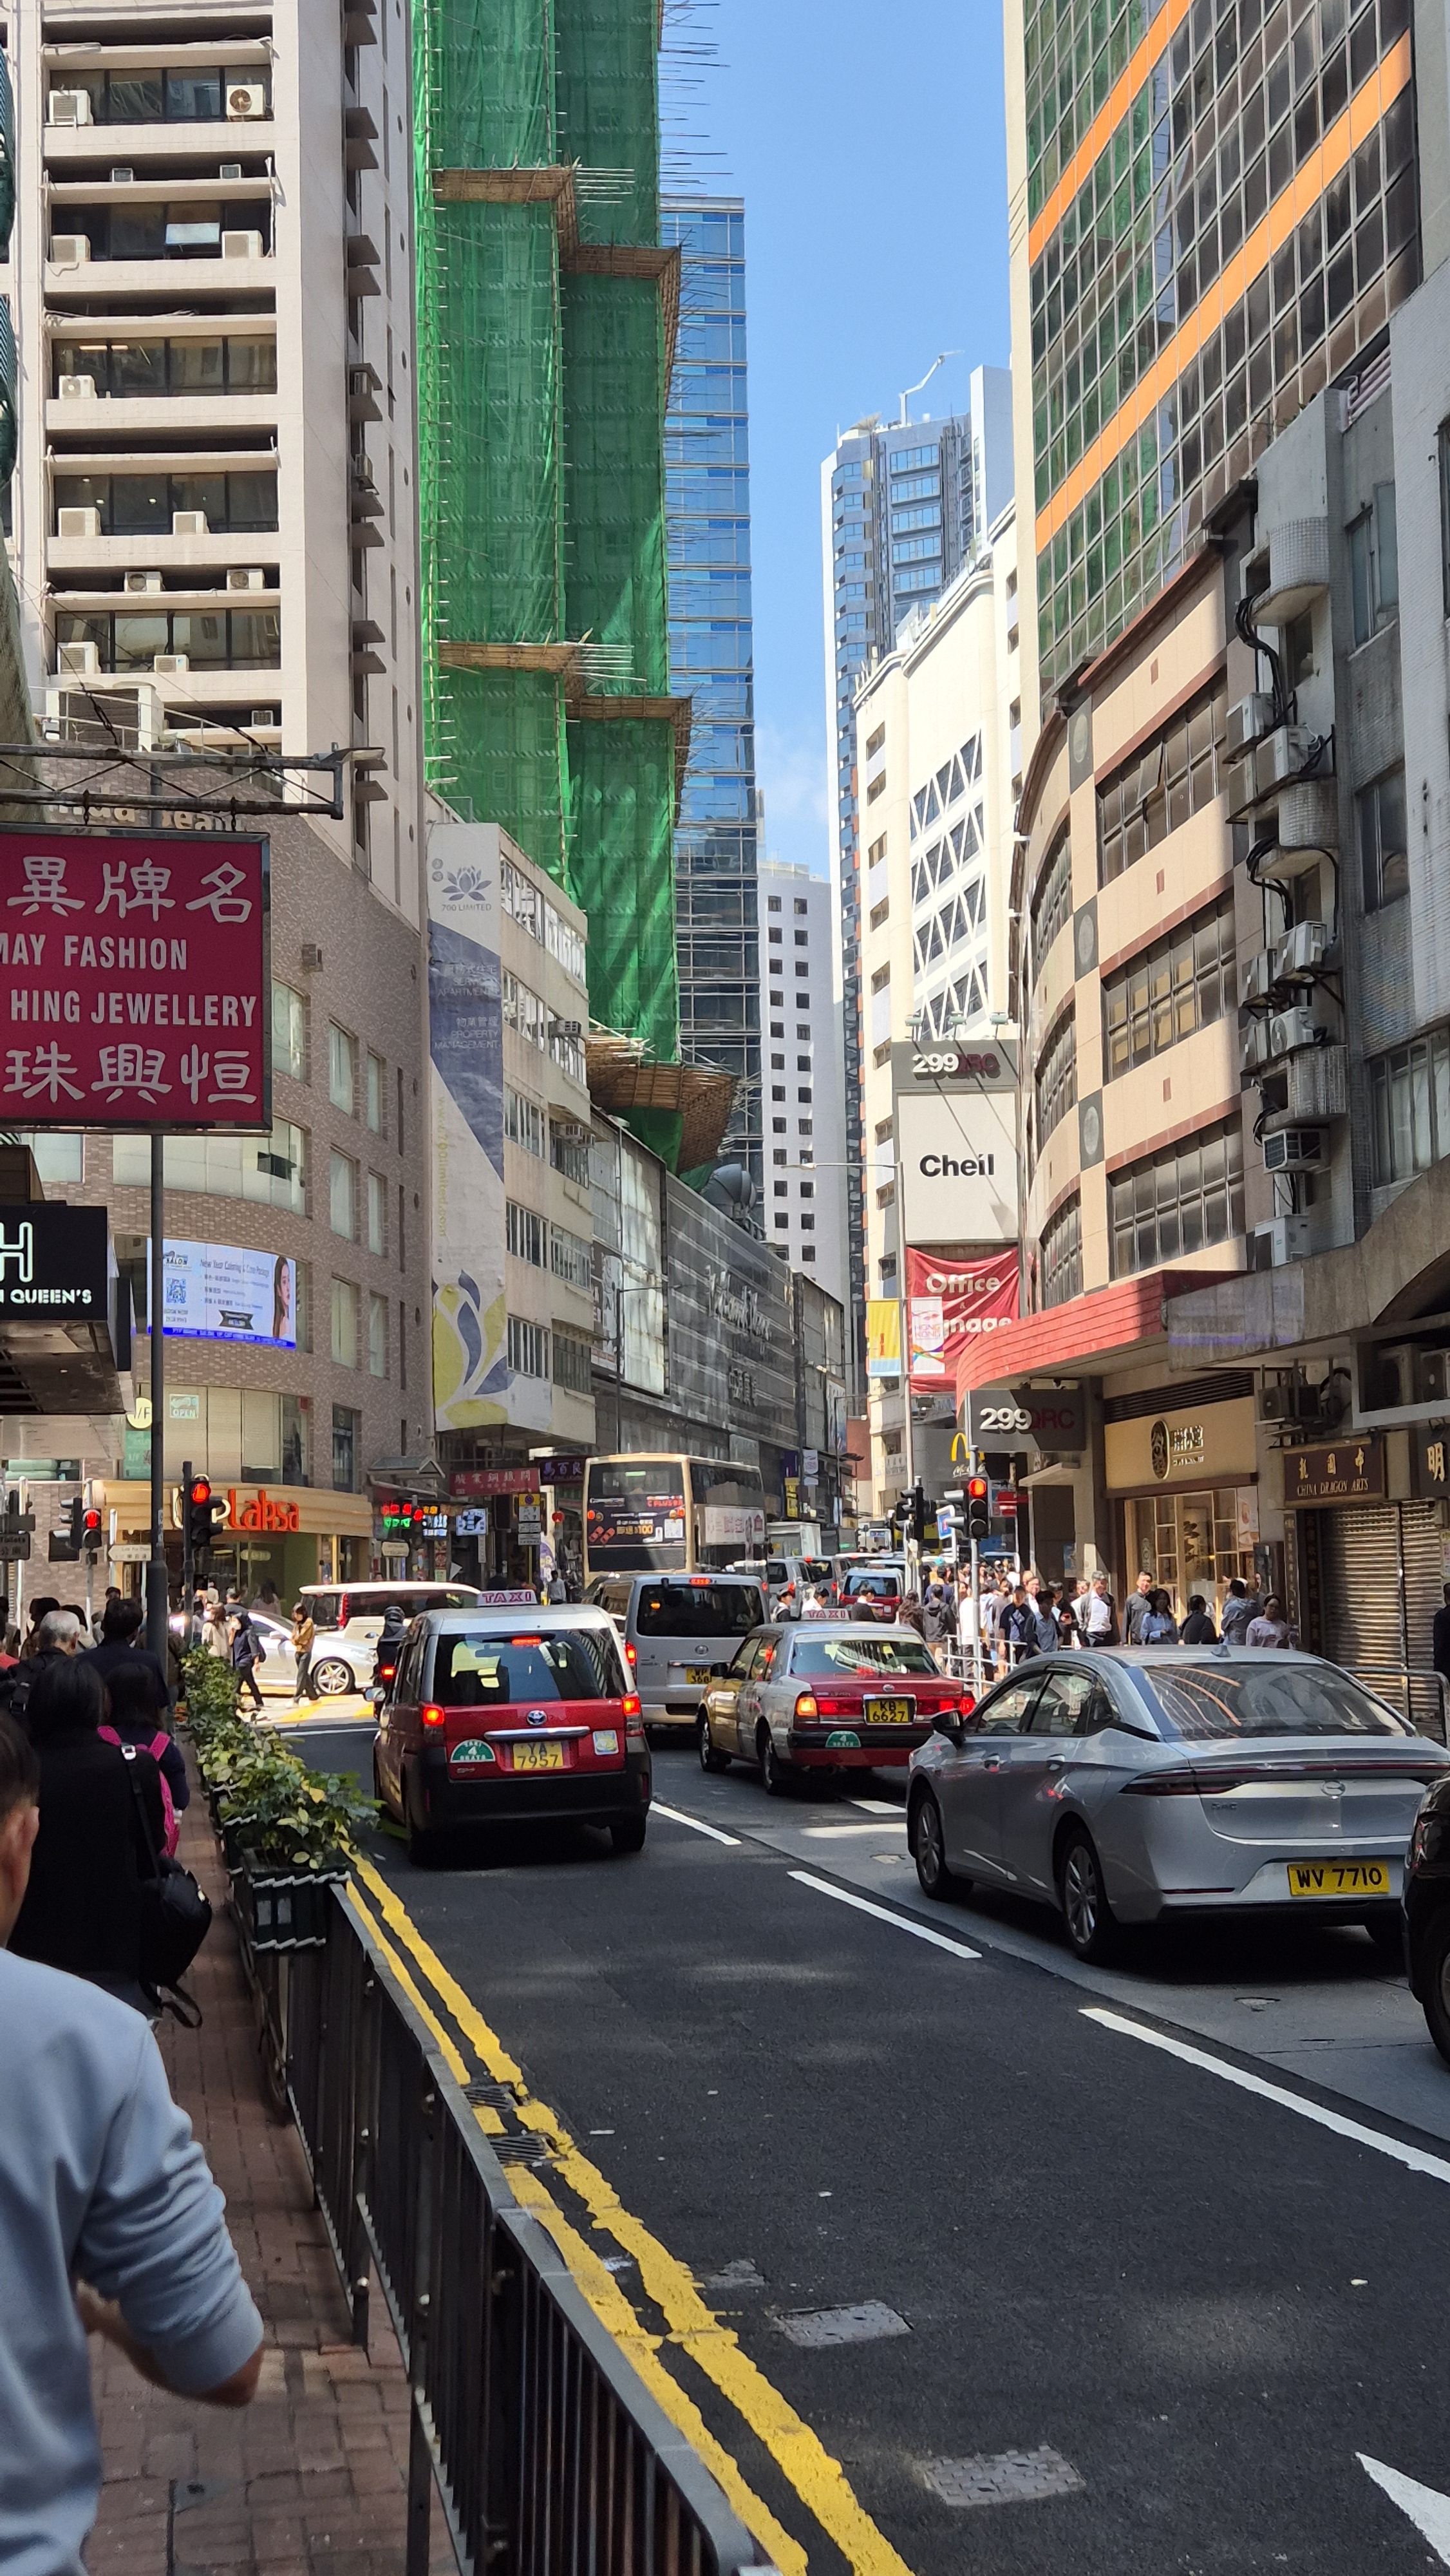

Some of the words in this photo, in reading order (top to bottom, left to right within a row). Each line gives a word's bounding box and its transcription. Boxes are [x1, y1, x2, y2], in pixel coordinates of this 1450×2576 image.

[64, 936, 187, 970] FASHION
[10, 990, 80, 1023] HING
[91, 992, 256, 1027] JEWELLERY
[919, 1153, 994, 1177] Cheil
[926, 1273, 1001, 1294] Office
[10, 1289, 92, 1304] QUEEN'S
[1297, 1484, 1317, 1497] CHINA
[1321, 1481, 1347, 1493] DRAGON
[1352, 1477, 1369, 1491] ARTS
[228, 1488, 299, 1531] Laksa
[482, 1591, 532, 1604] TAXI
[807, 1610, 845, 1618] TAXI
[880, 1701, 897, 1712] KB
[872, 1710, 905, 1722] 6627
[468, 1746, 477, 1756] 4
[527, 1743, 548, 1756] YA
[516, 1754, 559, 1768] 7957
[1296, 1868, 1324, 1888] WV
[1332, 1867, 1382, 1888] 7710
